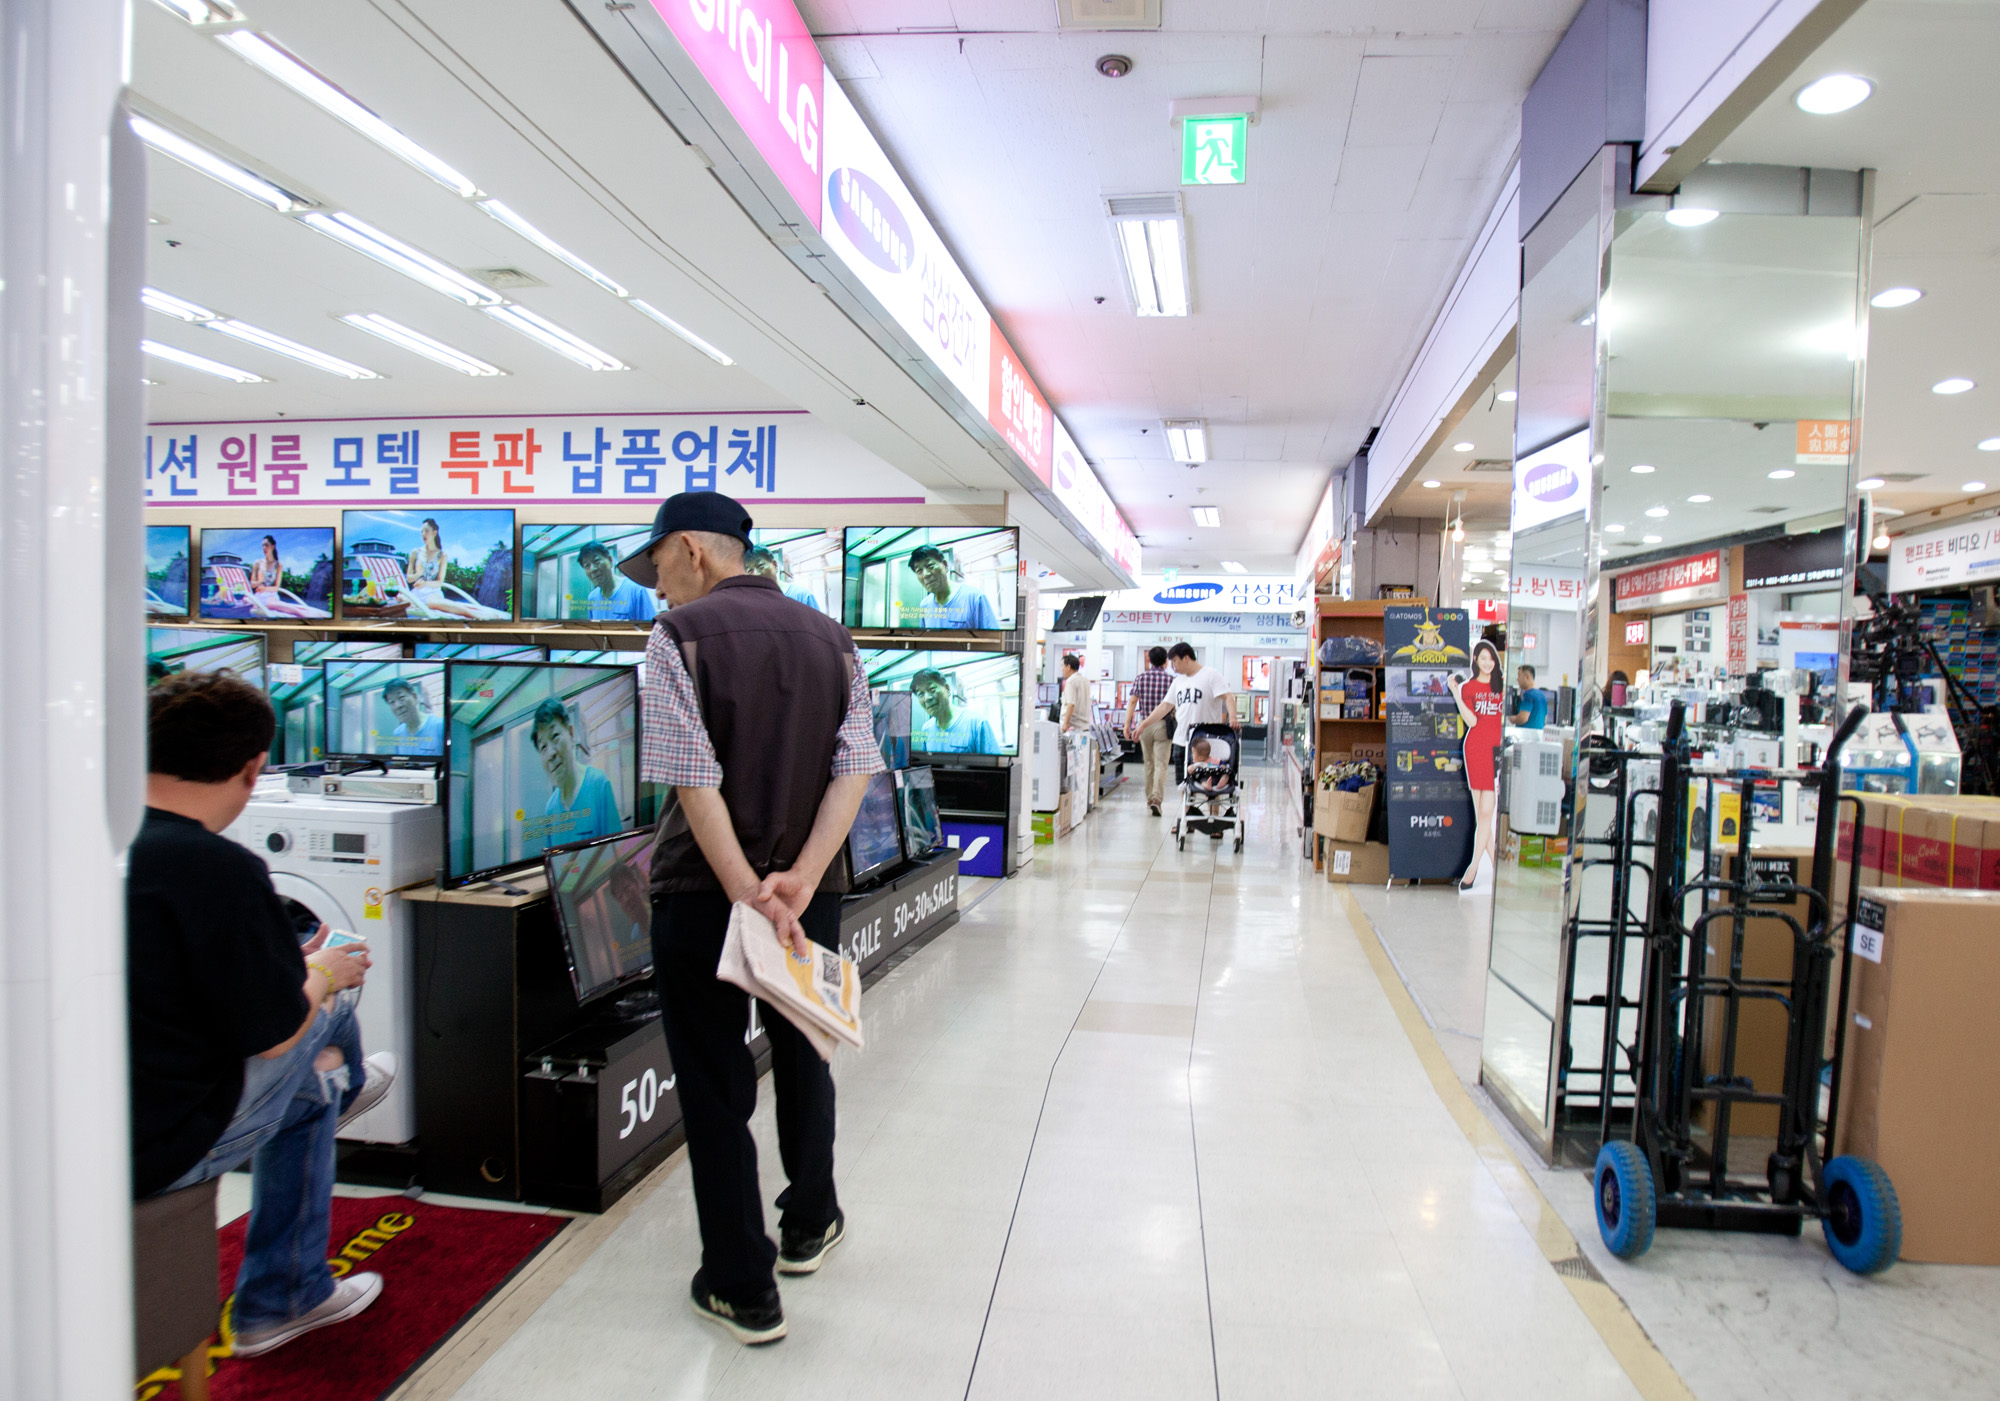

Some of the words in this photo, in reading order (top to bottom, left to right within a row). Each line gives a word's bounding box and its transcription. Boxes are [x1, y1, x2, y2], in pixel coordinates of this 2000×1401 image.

[778, 42, 818, 175] LG
[840, 167, 907, 271] SAMSUNG
[921, 252, 976, 382] 삼성전자
[144, 434, 198, 496] 션
[217, 433, 308, 496] 원룸
[325, 430, 420, 495] 모텔
[440, 427, 542, 495] 특판
[562, 424, 777, 494] 납품업체
[1948, 533, 1980, 555] 비디오
[1160, 588, 1216, 599] SAMSUNG
[1230, 583, 1304, 605] 삼성전
[1102, 611, 1172, 625] D.스마트TV
[1202, 615, 1240, 625] WHISEN
[1256, 615, 1274, 627] 삼성
[1277, 615, 1291, 627] ha
[1411, 654, 1448, 664] SHOGUN
[1176, 687, 1203, 707] GAP
[1475, 700, 1498, 715] 캐논
[1860, 934, 1876, 953] SE
[619, 1067, 676, 1141] 50~
